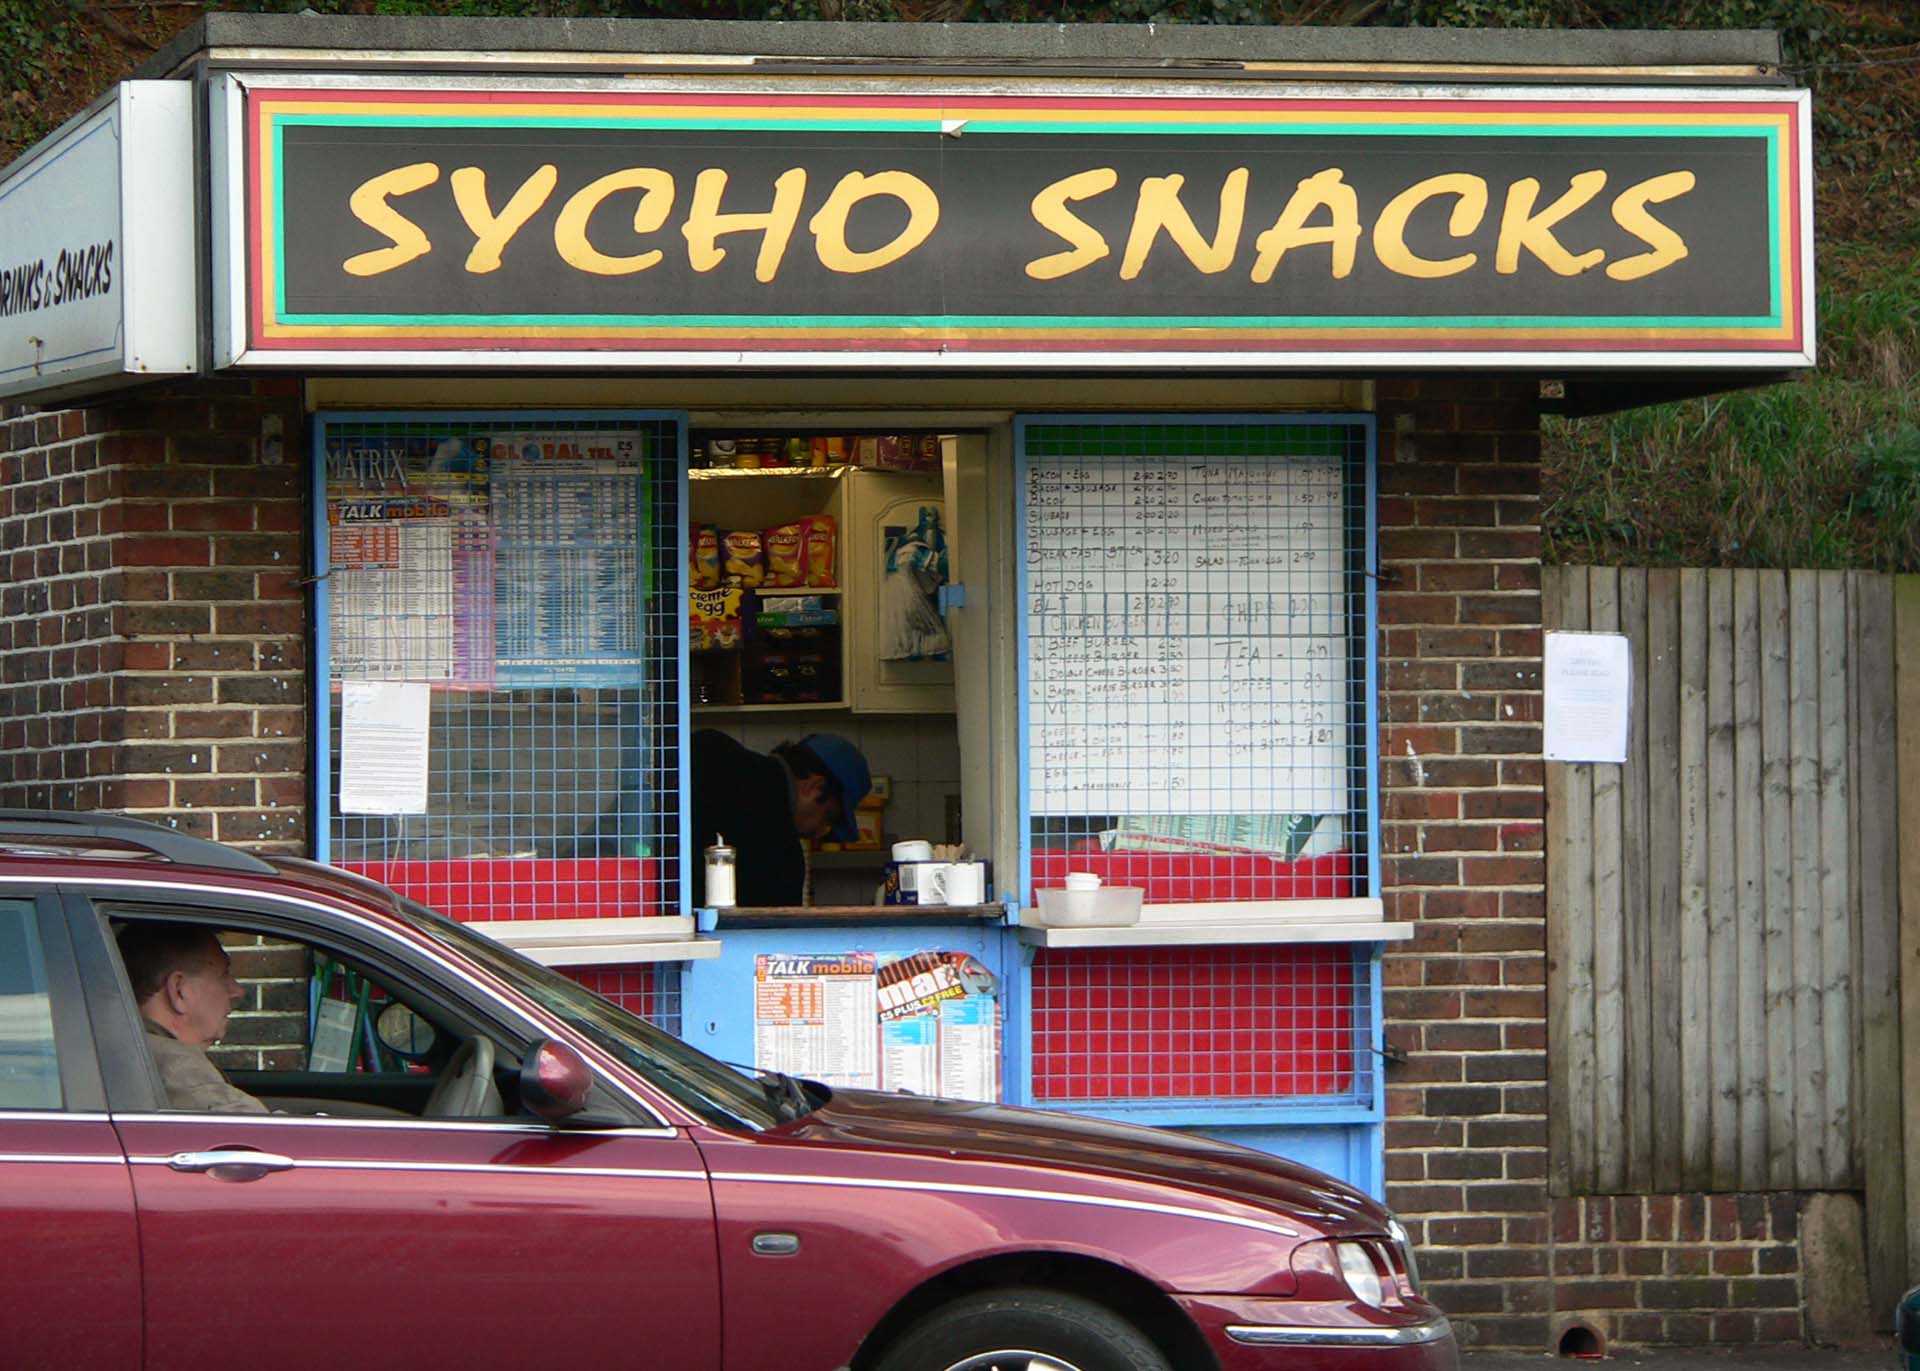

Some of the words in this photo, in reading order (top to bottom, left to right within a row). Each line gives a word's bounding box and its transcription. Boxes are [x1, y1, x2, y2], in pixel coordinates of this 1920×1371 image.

[343, 162, 939, 282] SYCHO
[1025, 168, 1695, 282] SNACKS
[53, 240, 113, 305] SNACKS
[327, 447, 408, 489] MATRIX
[338, 505, 383, 519] TALK
[690, 587, 734, 602] creme
[696, 601, 725, 616] egg
[1214, 640, 1261, 669] TEA
[767, 960, 810, 974] TALK
[813, 957, 873, 974] mobile
[894, 1000, 921, 1017] PLUS
[935, 985, 963, 1002] FREE
